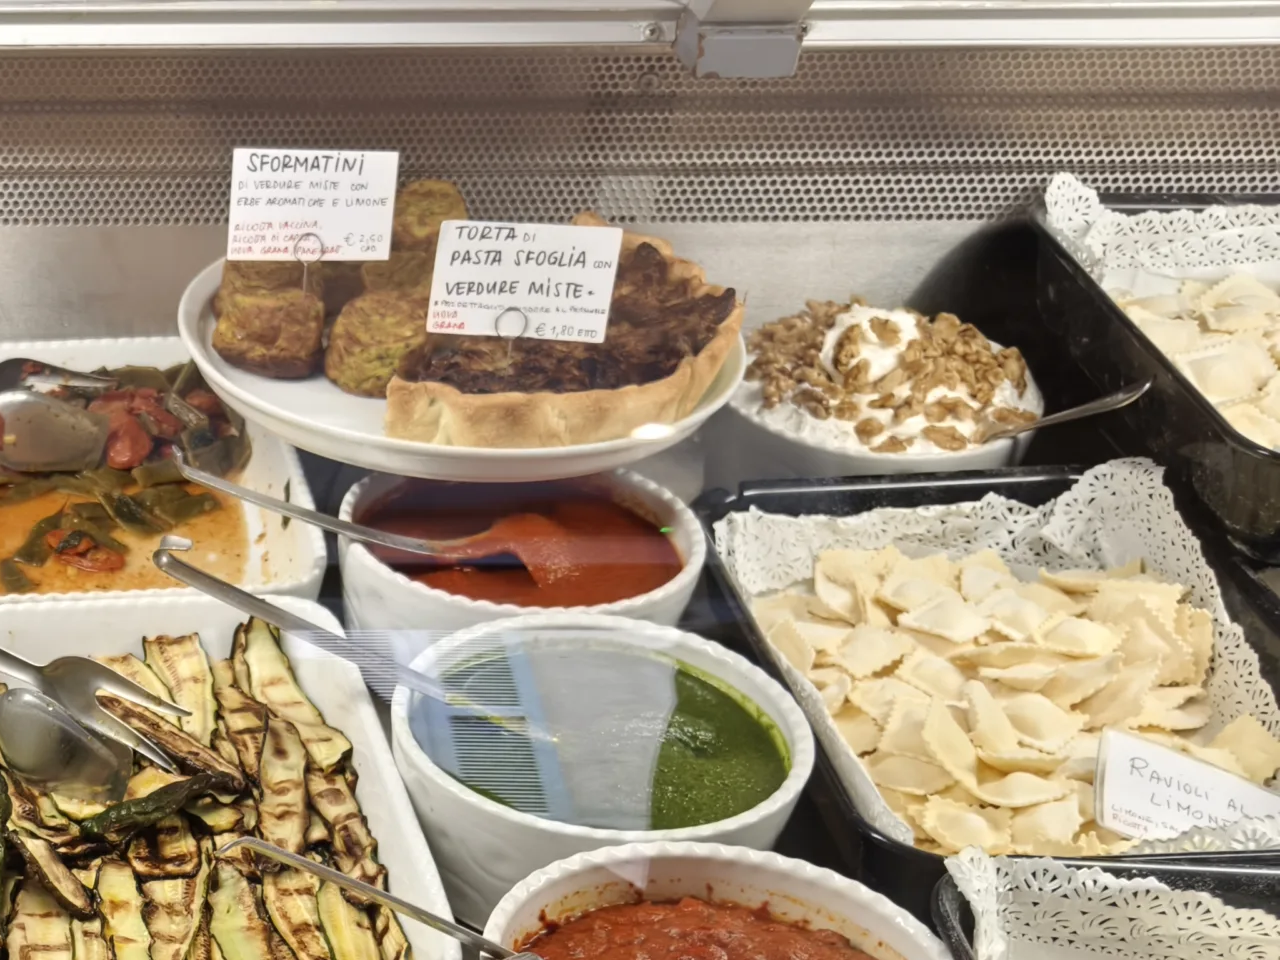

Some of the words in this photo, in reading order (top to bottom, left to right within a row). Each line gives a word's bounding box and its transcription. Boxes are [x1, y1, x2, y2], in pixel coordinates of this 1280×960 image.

[246, 152, 365, 176] SFORMATINI
[254, 180, 303, 190] VERDURE
[309, 179, 340, 191] MISTE
[350, 182, 369, 191] CON
[236, 198, 262, 207] ERBE
[345, 197, 389, 207] LIMONE
[455, 225, 518, 242] TORTA
[522, 232, 537, 243] DI
[449, 249, 502, 267] PASTA
[514, 246, 587, 269] SFOGLIA
[593, 260, 612, 269] CON
[445, 280, 520, 297] VERDURE
[1128, 756, 1210, 801] RAVIOLI
